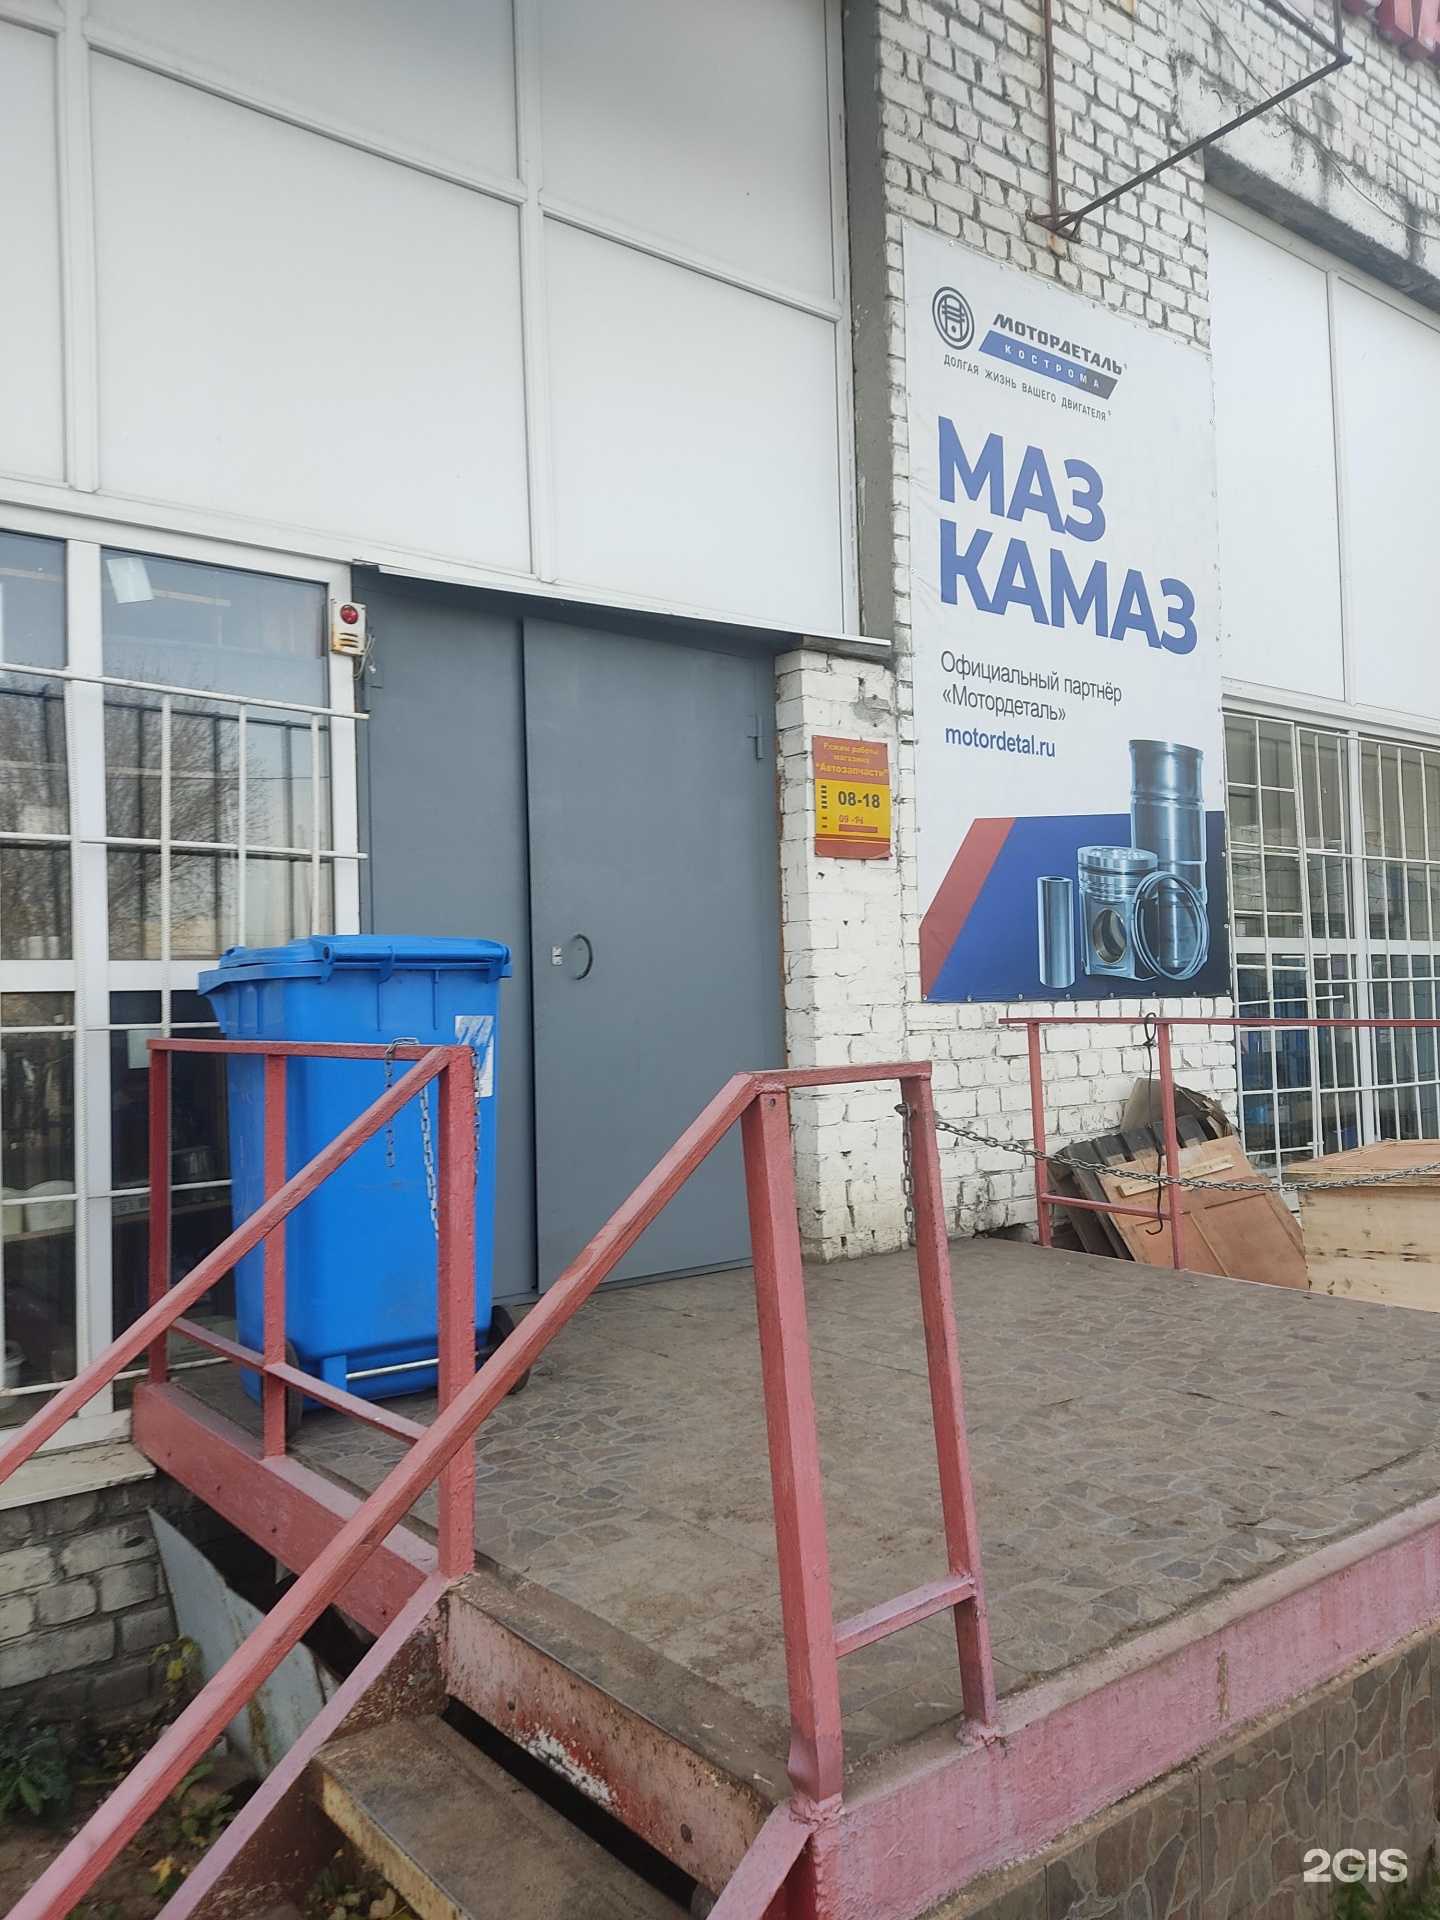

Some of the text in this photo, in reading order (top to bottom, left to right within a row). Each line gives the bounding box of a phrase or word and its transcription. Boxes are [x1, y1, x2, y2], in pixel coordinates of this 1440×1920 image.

[993, 313, 1122, 376] МОТОРДЕТАЛЬ
[1004, 343, 1100, 389] КОСТРОМА
[943, 354, 1106, 421] ДОЛГАЯ ЖИЗНЬ ВАШЕГО ДВИГАТЕЛЯ
[938, 415, 1106, 541] МАЗ
[940, 518, 1197, 655] КАМАЗ
[940, 650, 1122, 706] Официальный партнёр
[942, 683, 1066, 721] «Мотордеталь»
[945, 727, 1056, 757] motordetal.ru
[838, 790, 881, 808] 08-18
